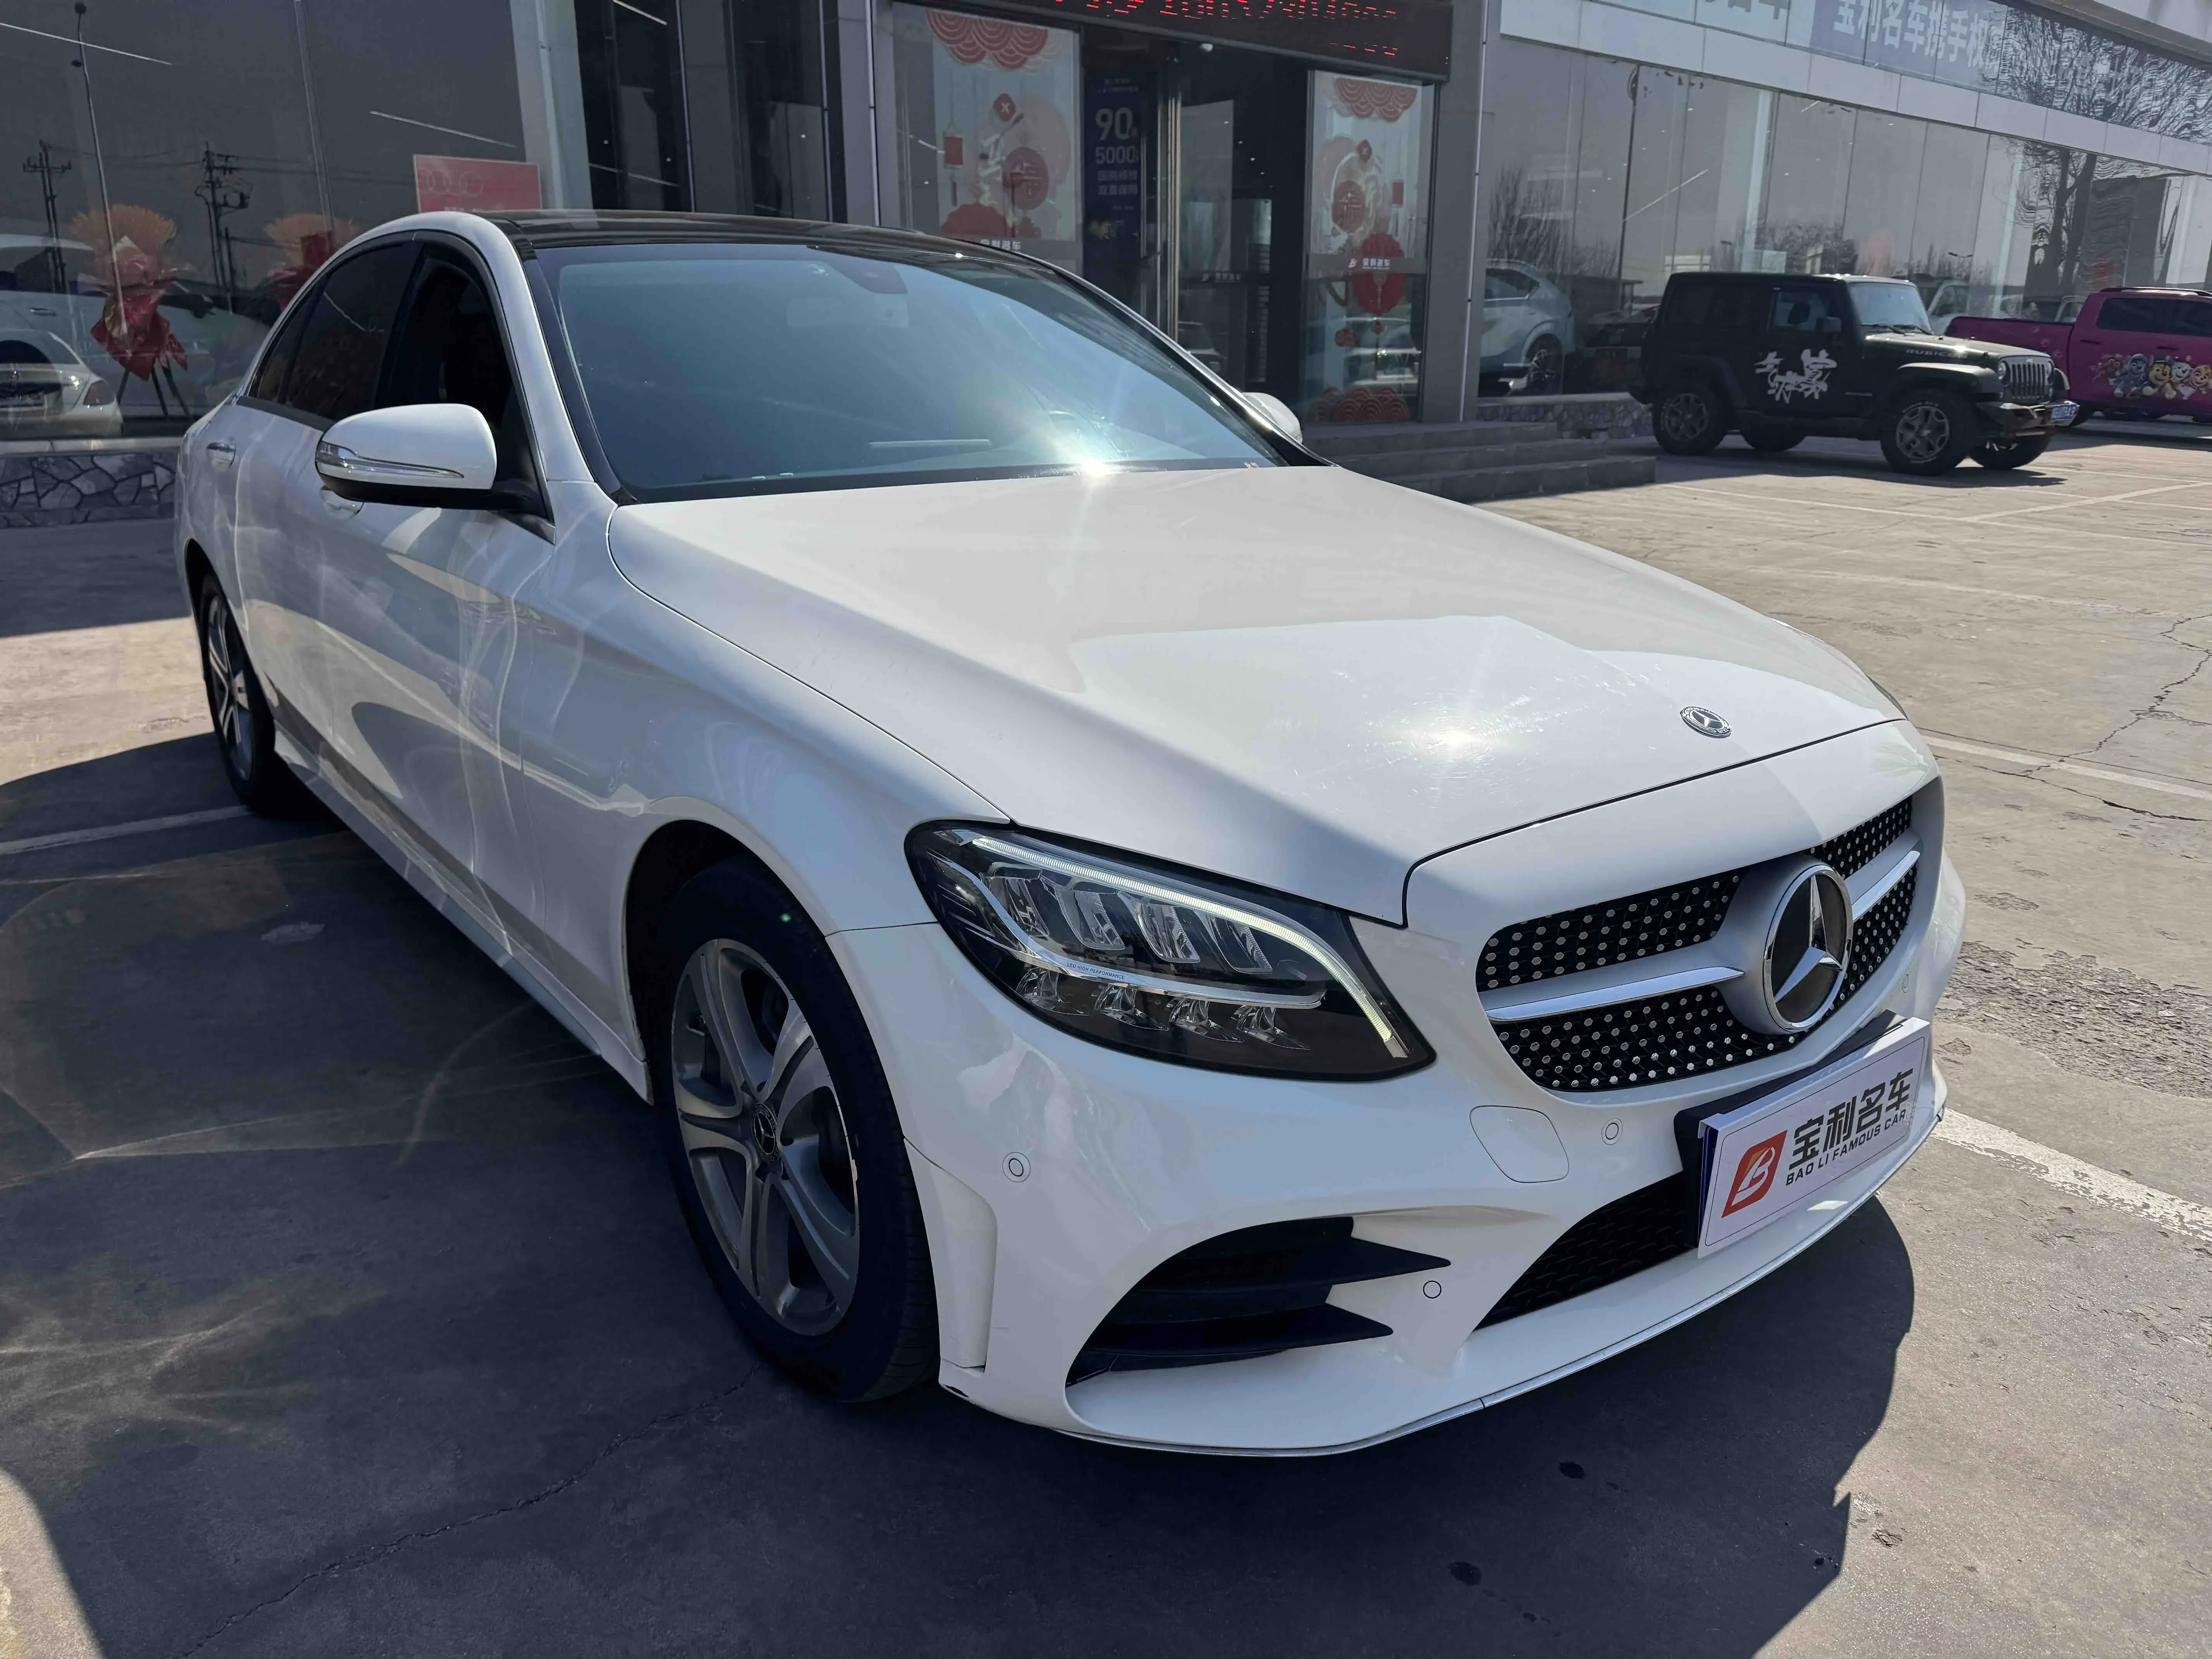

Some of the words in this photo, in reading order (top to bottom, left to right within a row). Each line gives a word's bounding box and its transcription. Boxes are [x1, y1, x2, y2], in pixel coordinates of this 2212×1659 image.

[1095, 107, 1133, 141] 90
[1095, 146, 1136, 164] 5000
[1905, 349, 1968, 359] RUBICON
[1090, 968, 1125, 979] PERFORMANCE
[1788, 1068, 1913, 1171] 宝利名车
[1786, 1163, 1813, 1186] BAO
[1817, 1155, 1829, 1169] LI
[1831, 1126, 1881, 1162] FAMOUS
[1884, 1109, 1906, 1131] CAR
